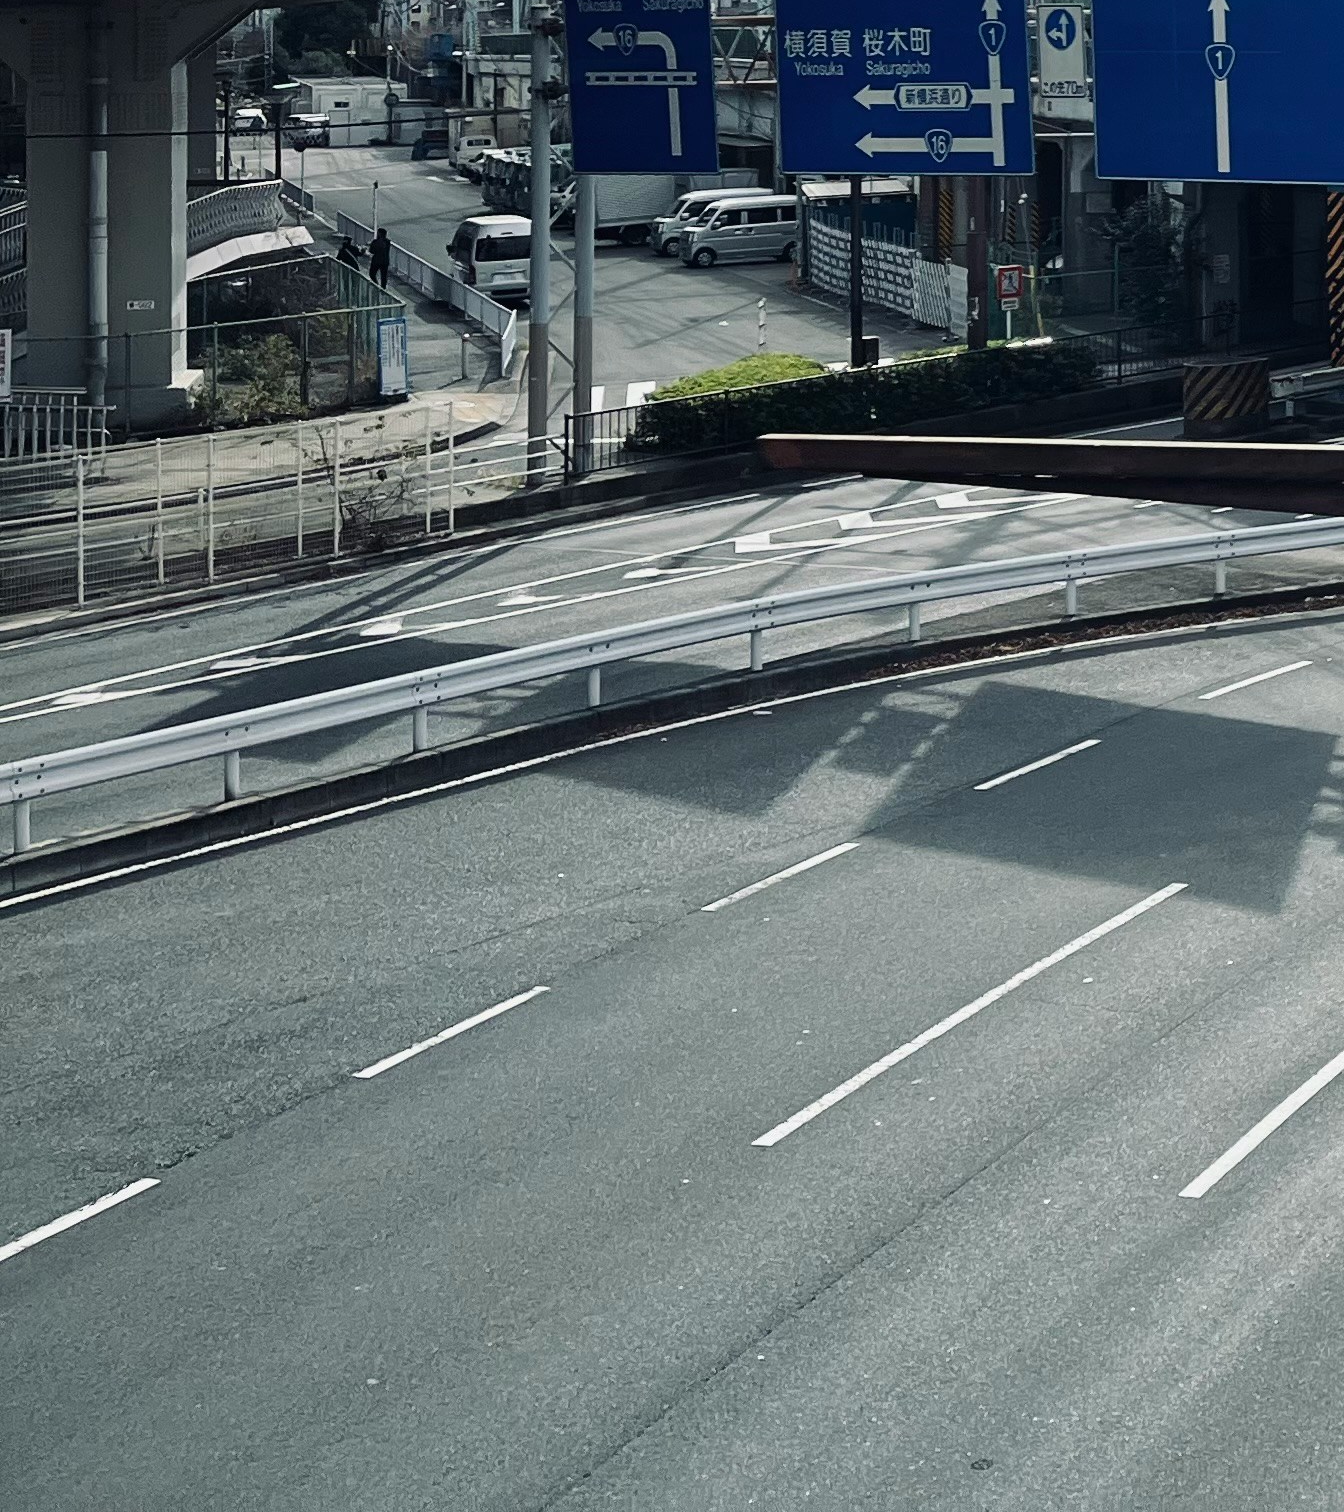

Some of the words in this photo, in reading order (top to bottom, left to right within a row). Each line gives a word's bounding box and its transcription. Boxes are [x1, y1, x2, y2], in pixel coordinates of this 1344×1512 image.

[618, 29, 633, 48] 16
[784, 28, 852, 58] 横須賀
[862, 27, 931, 57] 桜木町
[988, 27, 996, 46] 1
[794, 60, 844, 76] Yokosuka
[865, 59, 932, 78] Sakuragicho
[1215, 50, 1223, 70] 1
[905, 88, 962, 105] 新横浜通り
[931, 135, 946, 153] 16
